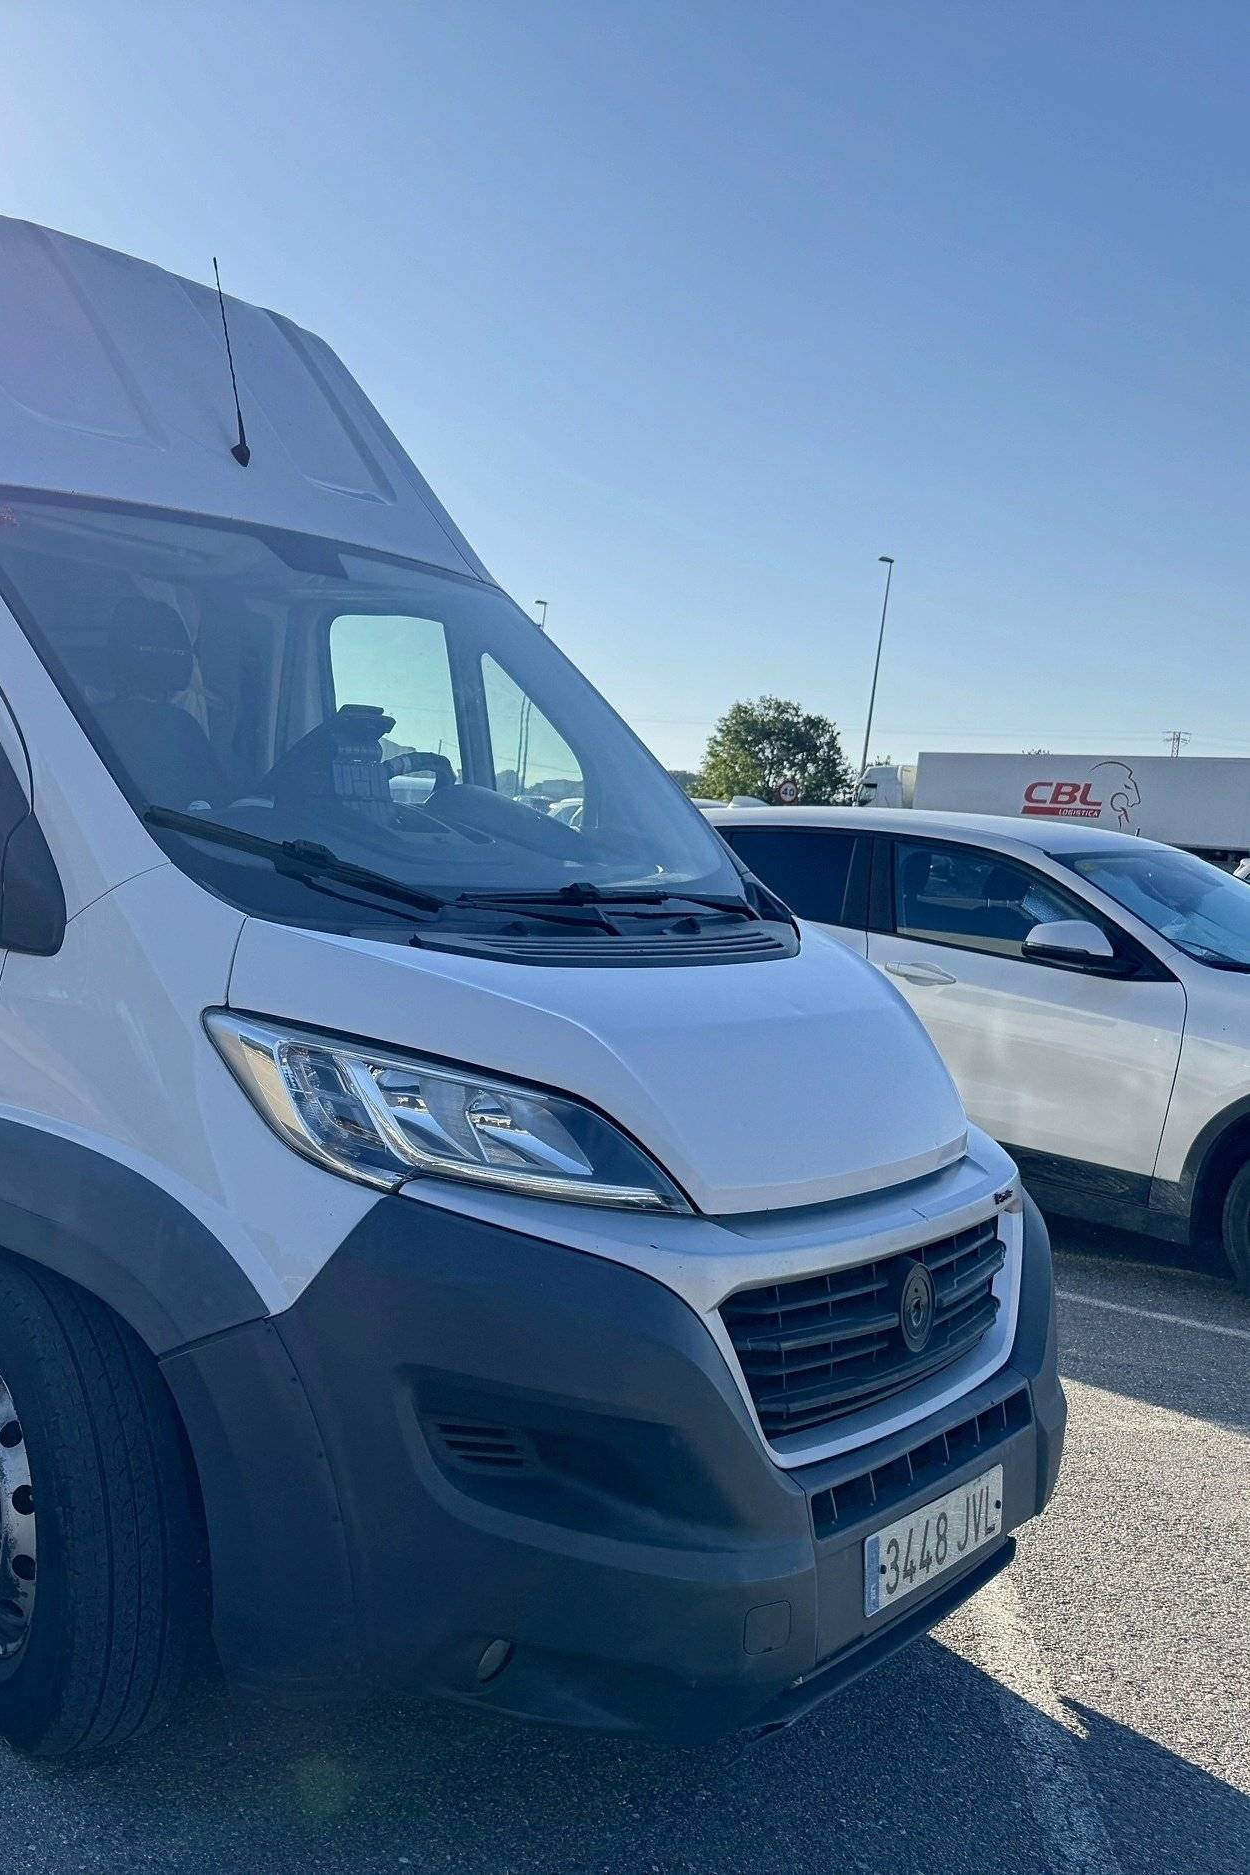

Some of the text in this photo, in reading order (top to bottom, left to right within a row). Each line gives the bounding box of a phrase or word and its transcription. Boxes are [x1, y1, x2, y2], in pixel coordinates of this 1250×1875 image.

[782, 788, 795, 797] 40
[1024, 782, 1102, 806] CBL
[885, 1486, 996, 1595] 3448 JVL
